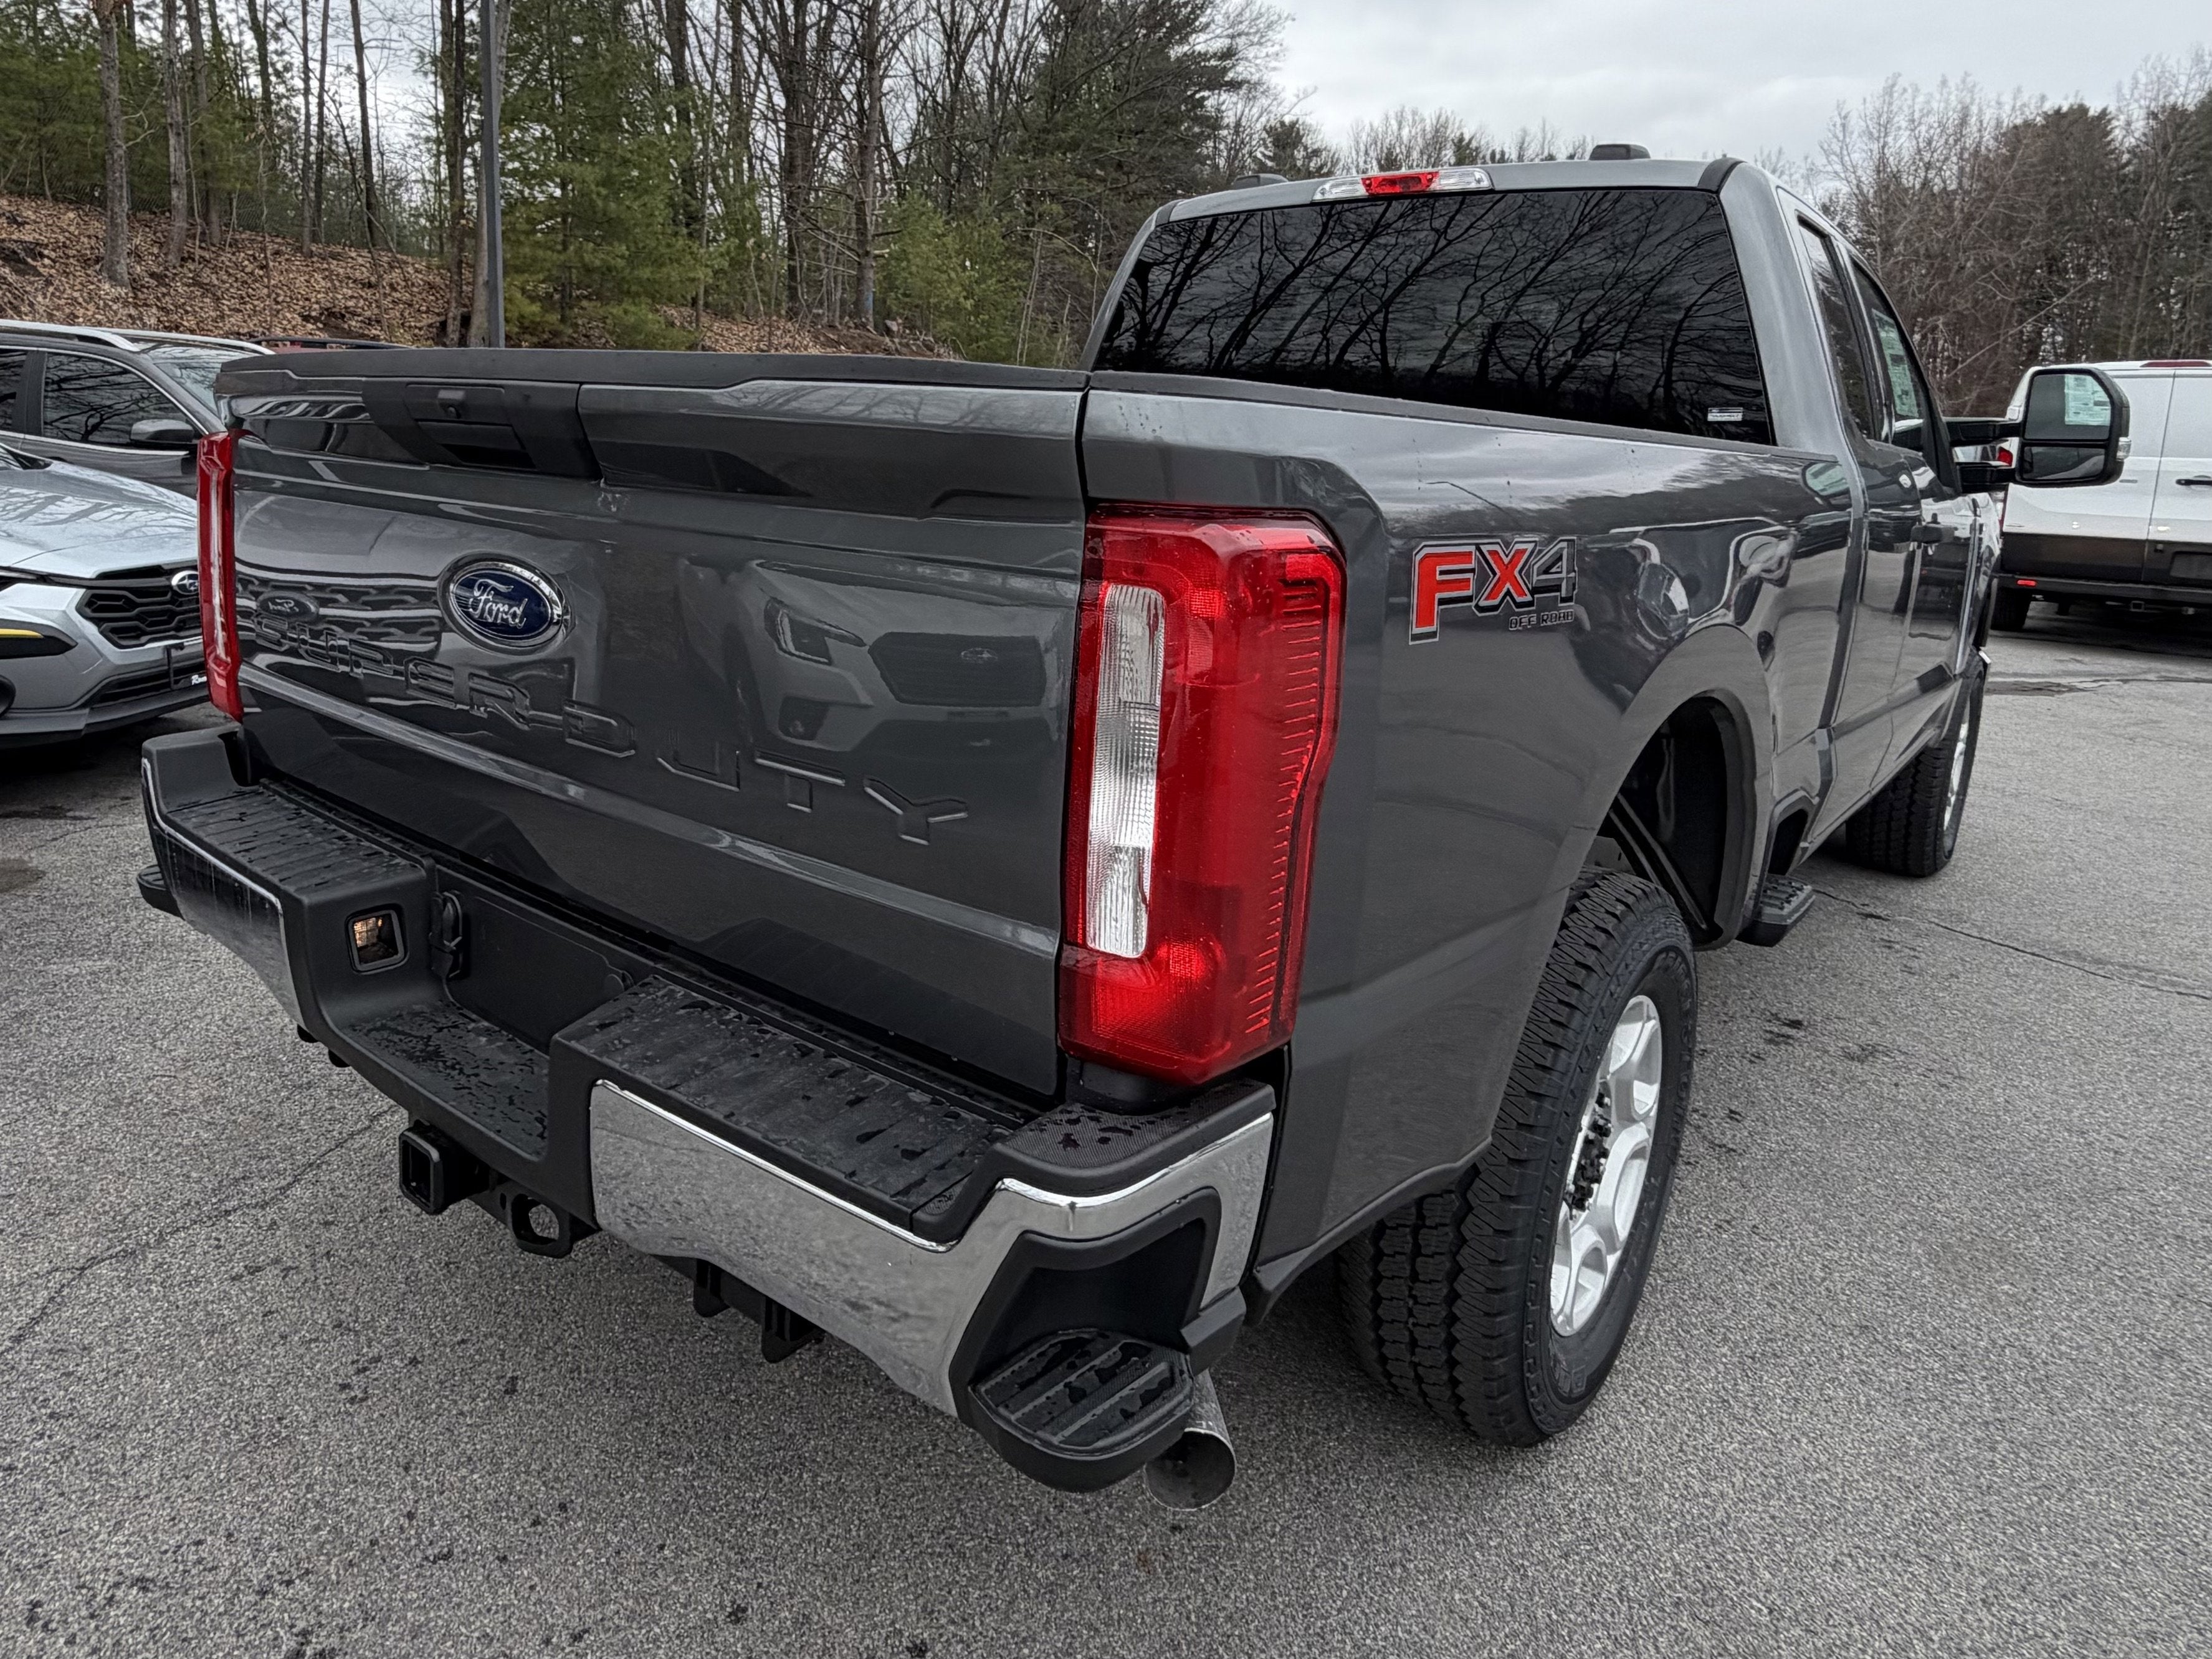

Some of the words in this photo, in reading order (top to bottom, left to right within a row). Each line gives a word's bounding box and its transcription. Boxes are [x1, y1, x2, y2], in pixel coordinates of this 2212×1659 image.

[469, 579, 528, 629] Ford
[1409, 537, 1578, 644] FX4
[1509, 614, 1537, 630] OFF
[1540, 609, 1575, 627] ROAD
[251, 612, 530, 730] SUPER
[563, 697, 969, 845] DUTY
